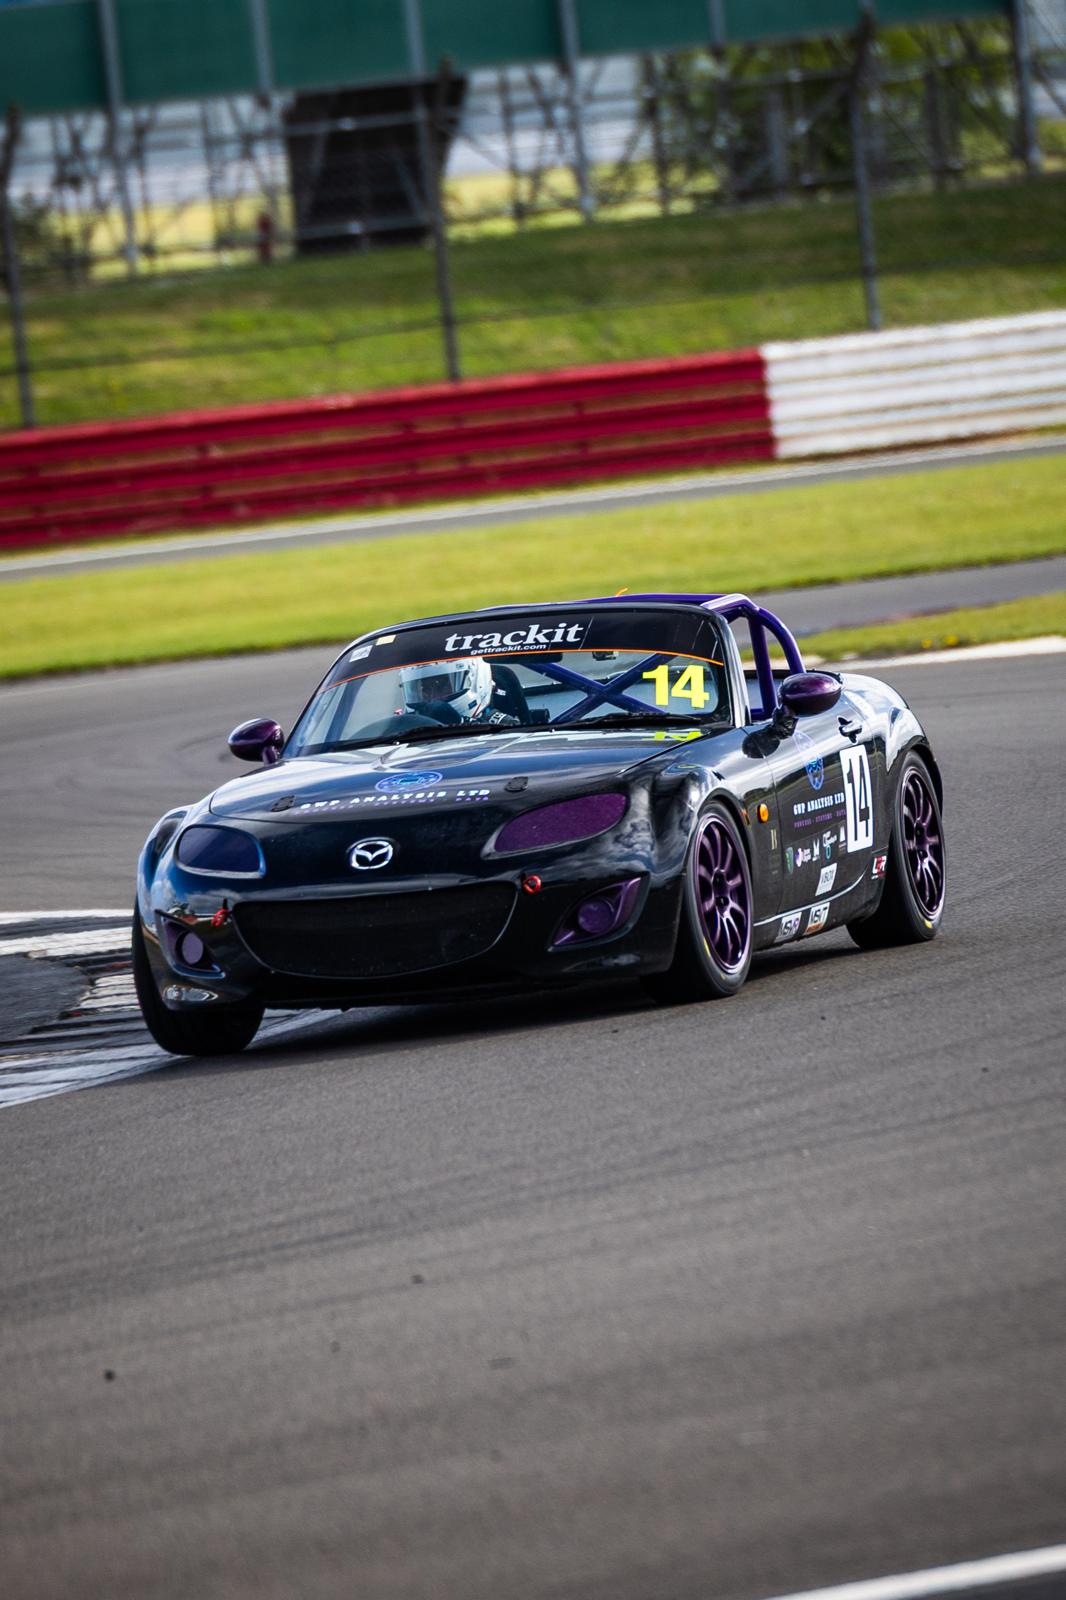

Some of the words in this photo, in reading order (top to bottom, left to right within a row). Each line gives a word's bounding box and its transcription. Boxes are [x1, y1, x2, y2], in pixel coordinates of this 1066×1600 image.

[445, 622, 584, 652] trackit
[470, 643, 547, 656] gettrackit.com
[642, 664, 709, 709] 14
[350, 790, 447, 804] ANALYSIS
[456, 789, 490, 797] LTD
[807, 794, 834, 813] ANALYSIS
[834, 792, 845, 805] LTD
[847, 754, 870, 842] 14
